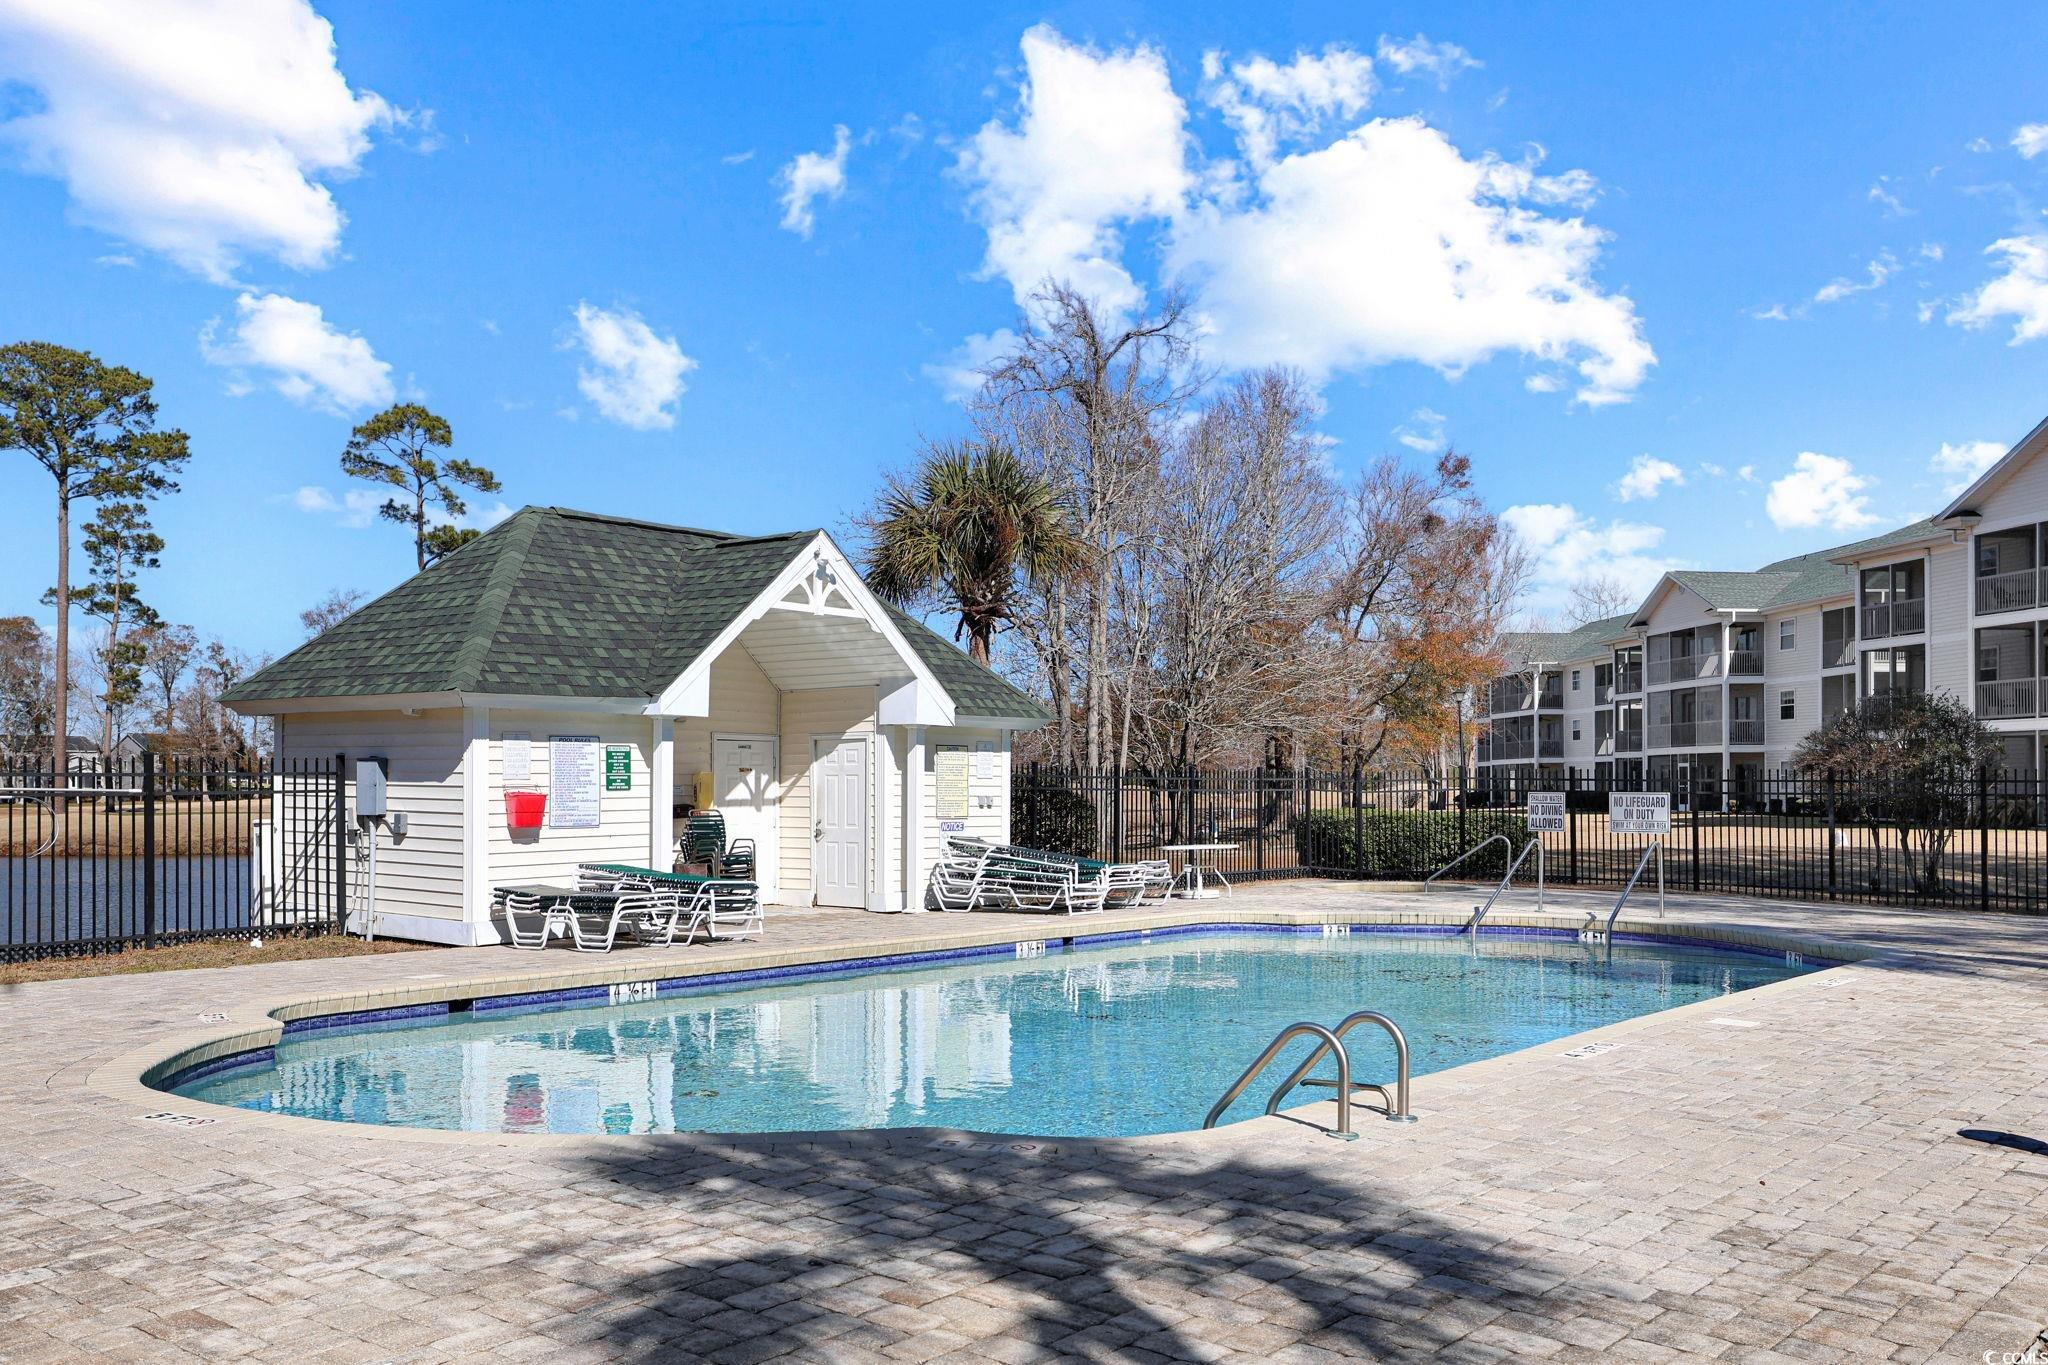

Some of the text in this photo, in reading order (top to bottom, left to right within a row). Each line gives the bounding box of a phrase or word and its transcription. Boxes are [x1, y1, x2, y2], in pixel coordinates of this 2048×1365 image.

[1613, 796, 1665, 808] NO LIFEGUARD
[1531, 804, 1562, 815] NO DIVING
[1624, 808, 1654, 820] ON DUTY
[941, 822, 964, 831] NOTICE
[1530, 818, 1562, 828] ALLOWED
